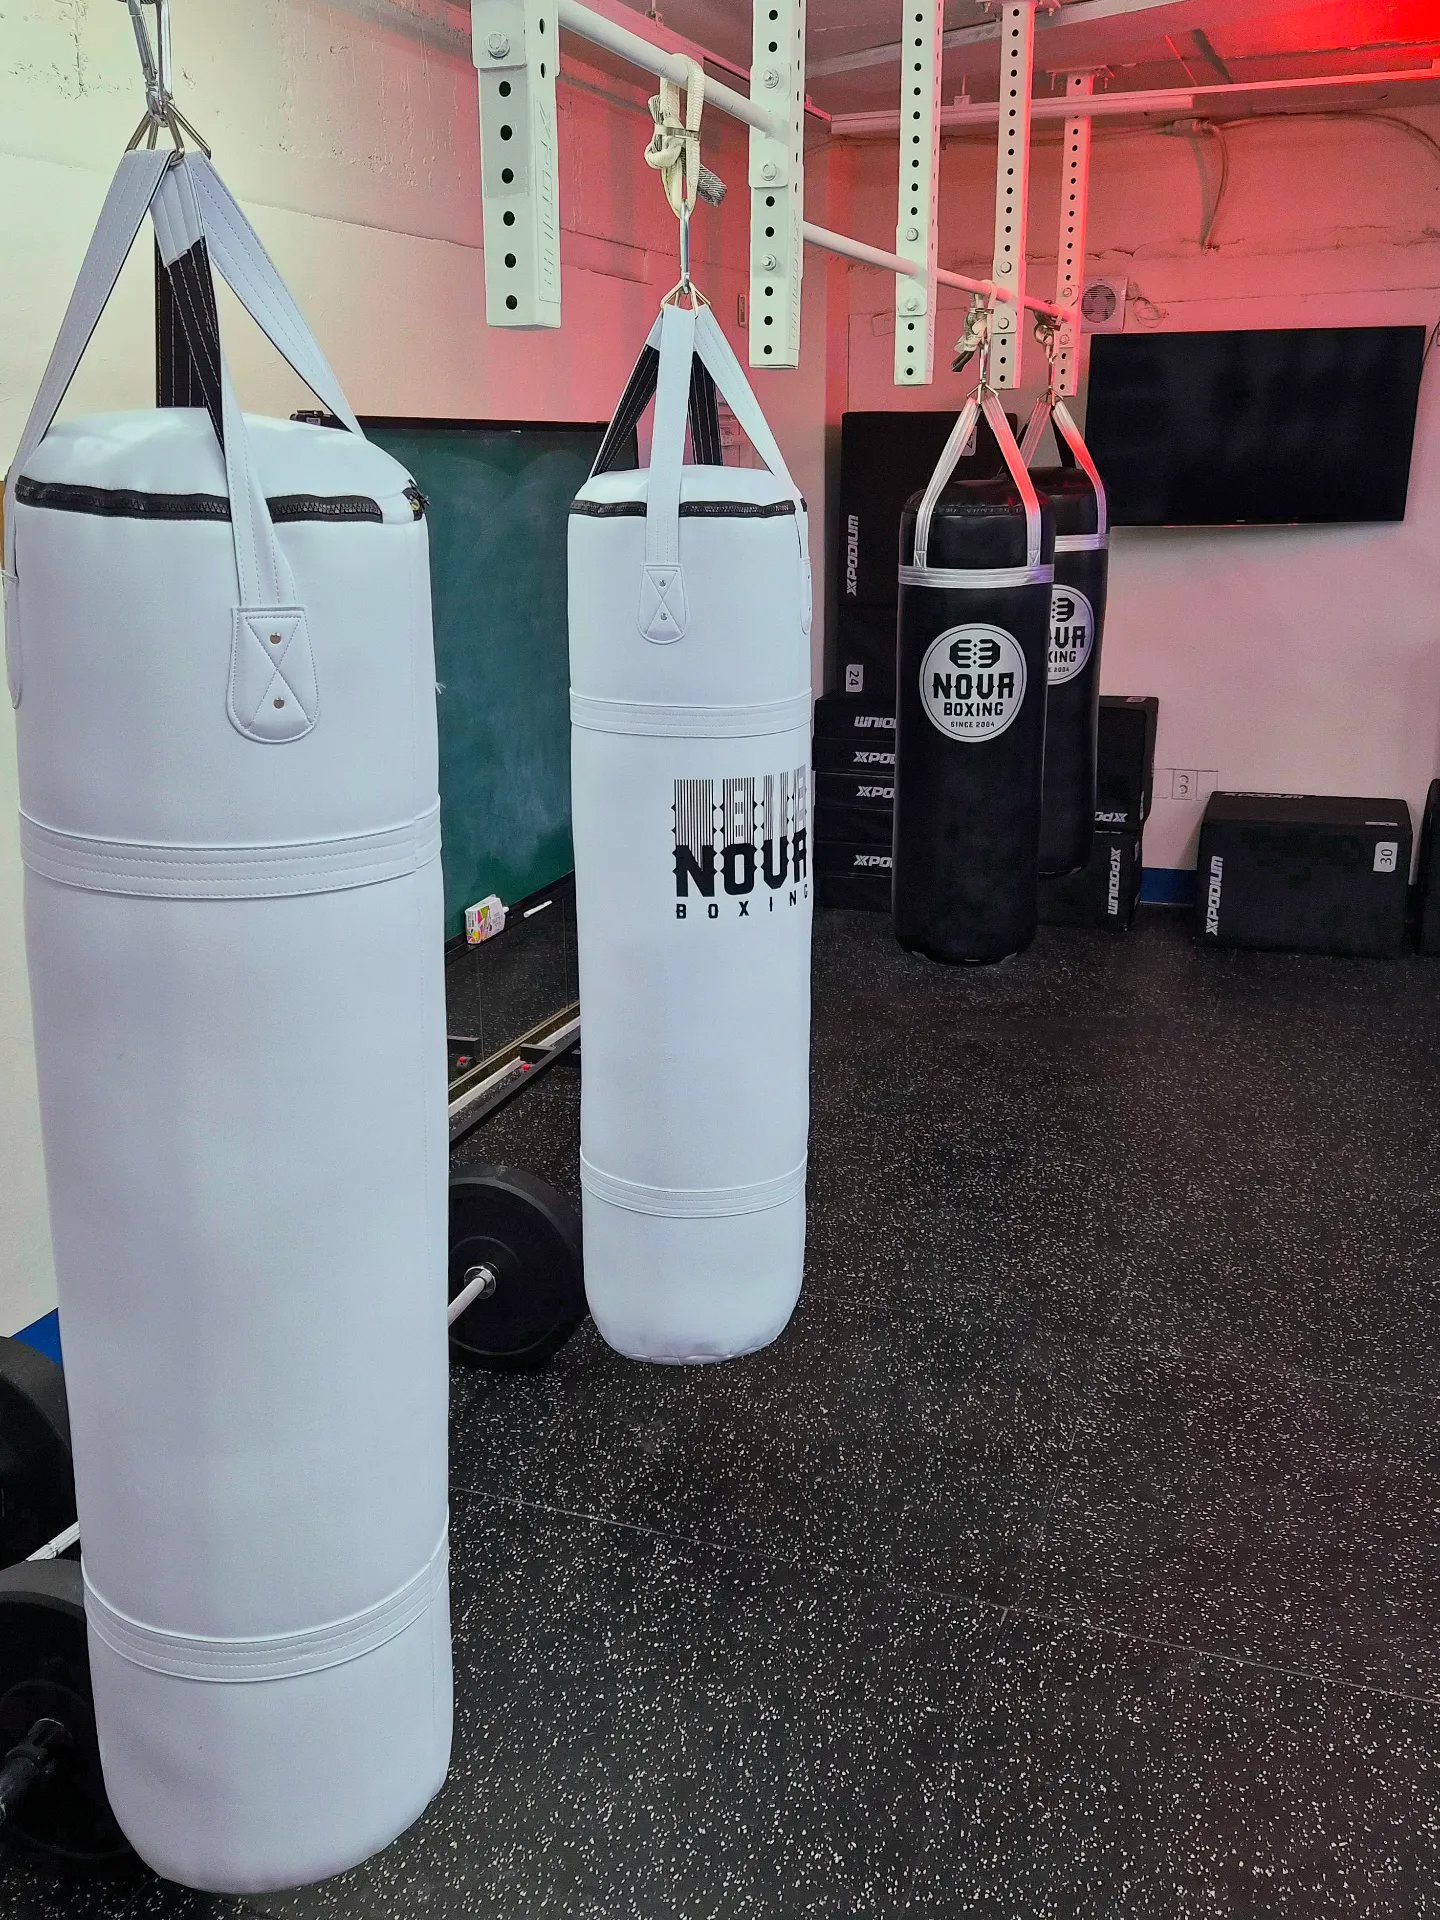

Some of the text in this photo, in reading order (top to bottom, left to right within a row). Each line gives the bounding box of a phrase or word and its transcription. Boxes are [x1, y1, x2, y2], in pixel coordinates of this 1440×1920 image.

[846, 514, 859, 597] XPODIUM
[1049, 626, 1086, 649] VA
[849, 670, 860, 687] 24
[932, 672, 1015, 700] NOVA
[943, 702, 1004, 717] BOXING
[854, 716, 897, 729] DIUM
[856, 786, 894, 799] XPO
[671, 828, 808, 897] NOVA
[853, 854, 893, 868] XPO
[1380, 849, 1393, 866] 30
[1107, 847, 1121, 915] XPODIUM
[676, 883, 808, 919] BOXING
[1205, 855, 1224, 937] XPODIUM
